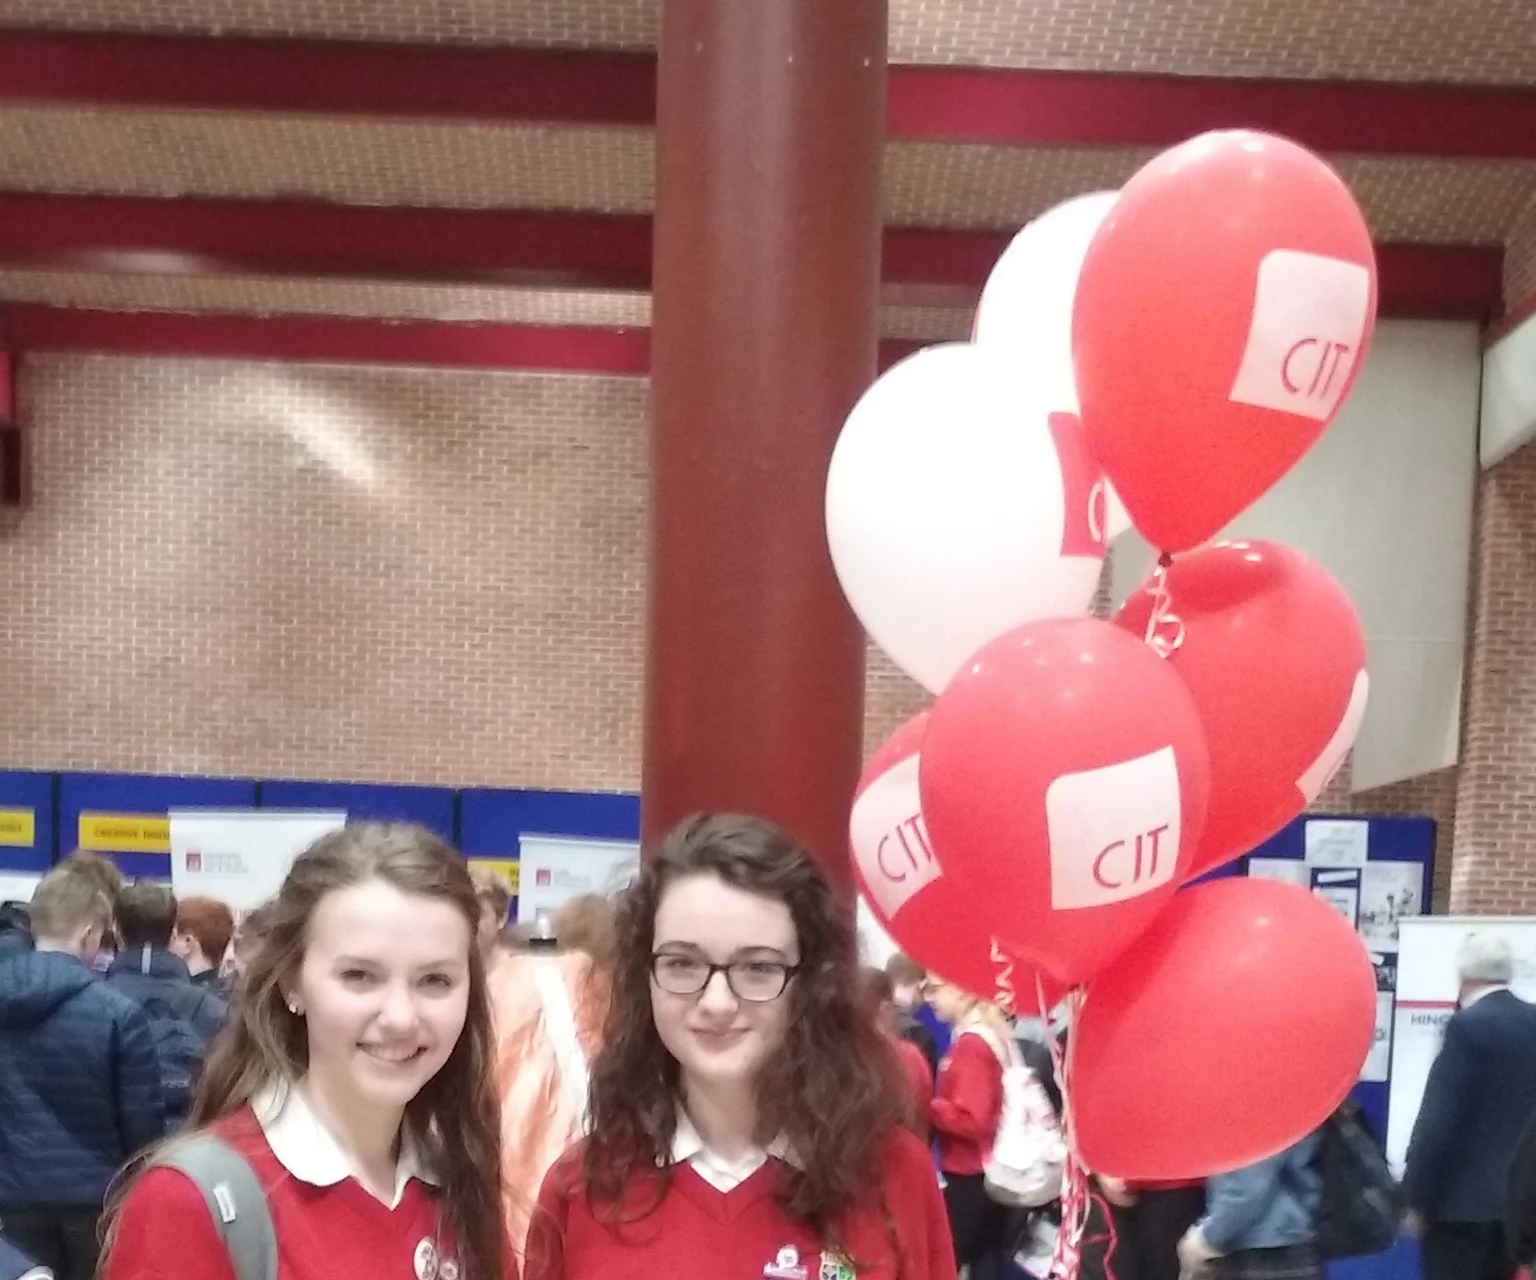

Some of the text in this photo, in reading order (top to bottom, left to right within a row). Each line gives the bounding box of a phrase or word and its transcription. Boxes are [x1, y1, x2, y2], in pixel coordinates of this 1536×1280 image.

[1280, 338, 1349, 399] CIT
[877, 811, 932, 883] CIT
[1092, 823, 1169, 889] CIT
[1411, 1013, 1453, 1026] HINC
